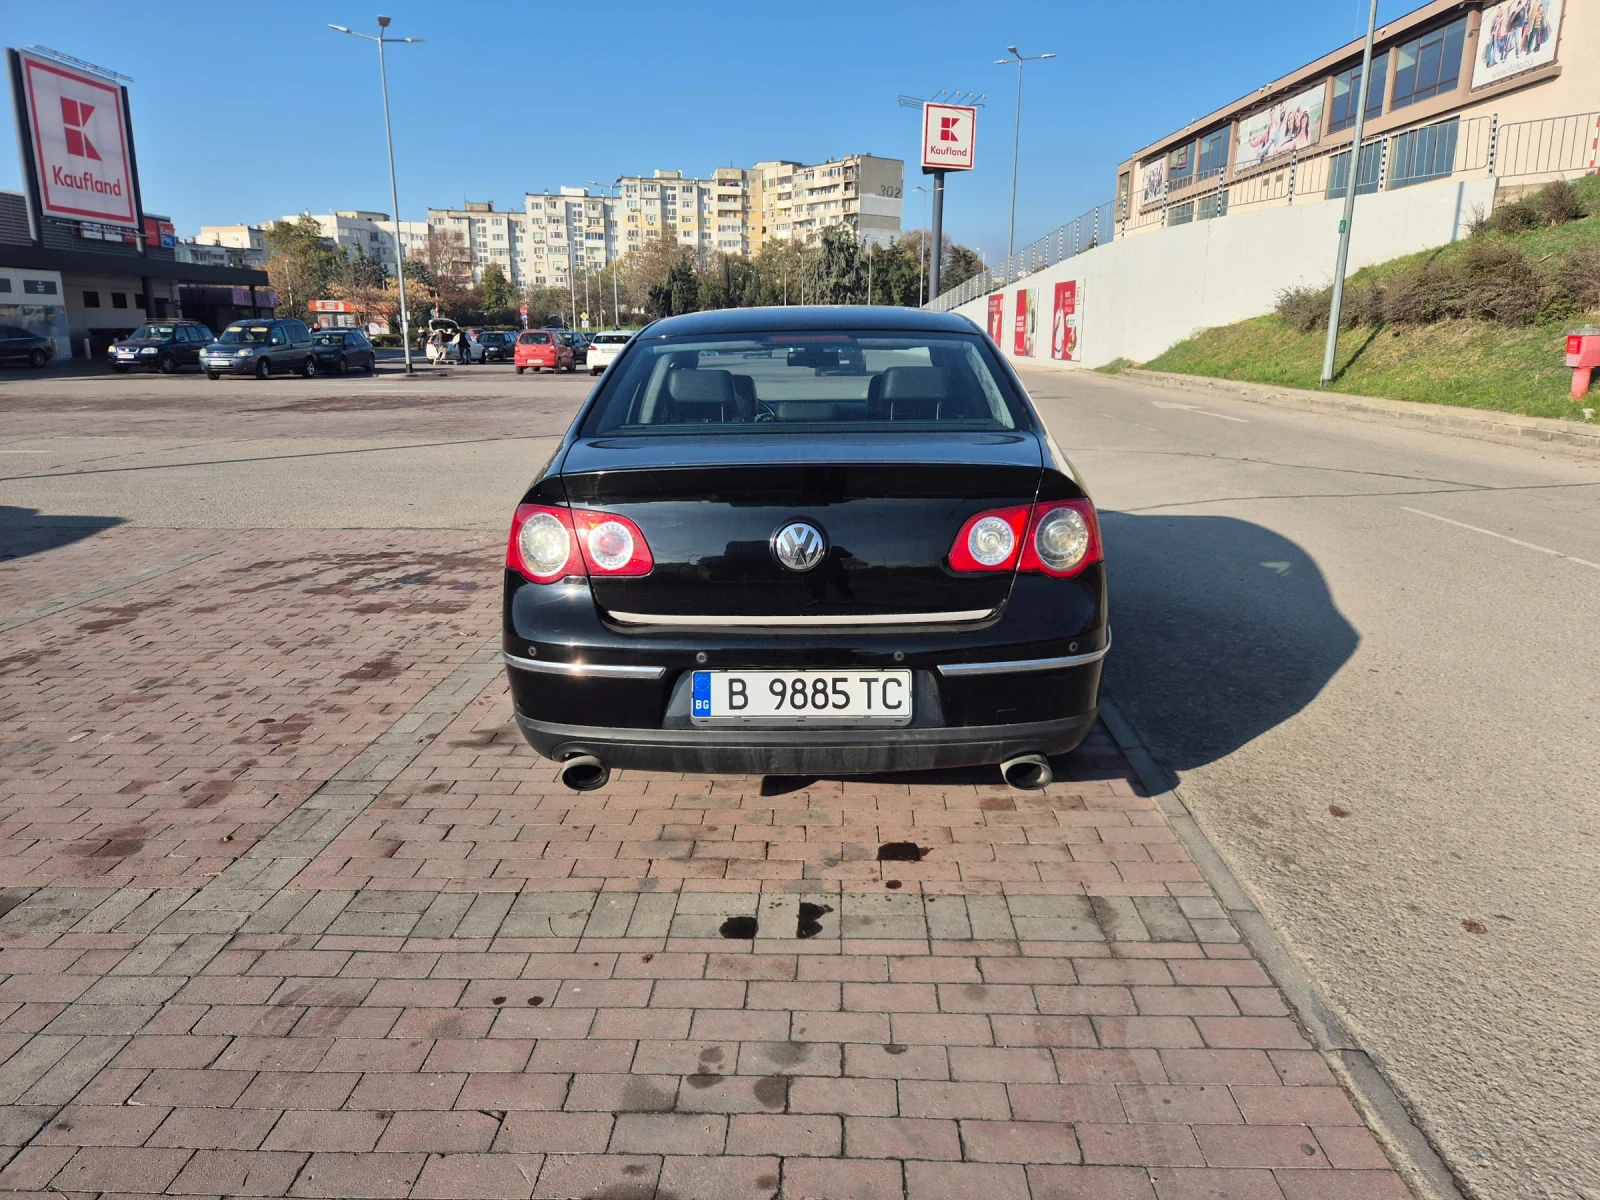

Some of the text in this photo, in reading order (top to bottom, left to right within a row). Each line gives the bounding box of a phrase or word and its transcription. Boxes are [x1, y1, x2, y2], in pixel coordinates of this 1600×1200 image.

[930, 145, 968, 157] Kaufland
[52, 164, 122, 197] Kaufland
[879, 184, 902, 199] 302
[728, 677, 903, 711] B 9885 TC
[695, 700, 710, 710] BG
